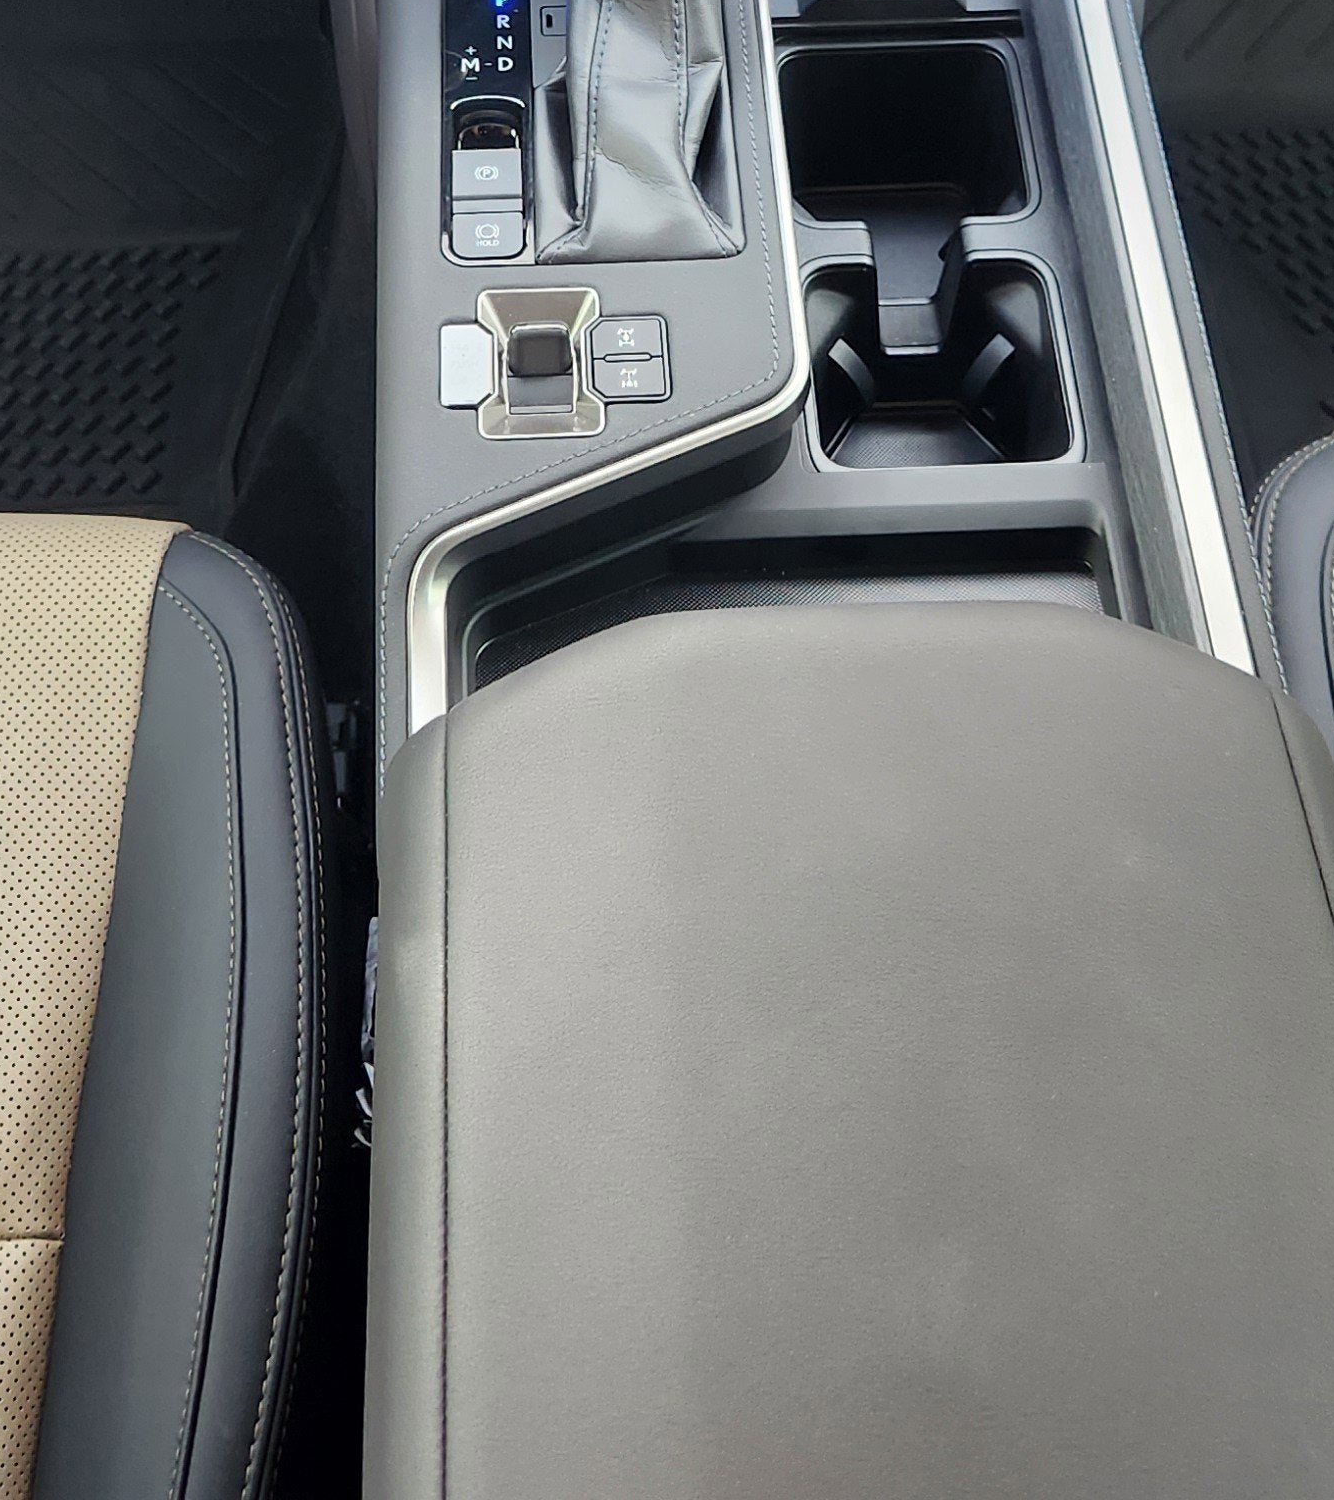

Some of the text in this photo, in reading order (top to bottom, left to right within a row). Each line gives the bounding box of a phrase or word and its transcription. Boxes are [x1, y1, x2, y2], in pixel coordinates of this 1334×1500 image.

[496, 14, 512, 30] R
[496, 35, 514, 50] N
[460, 56, 514, 73] M D
